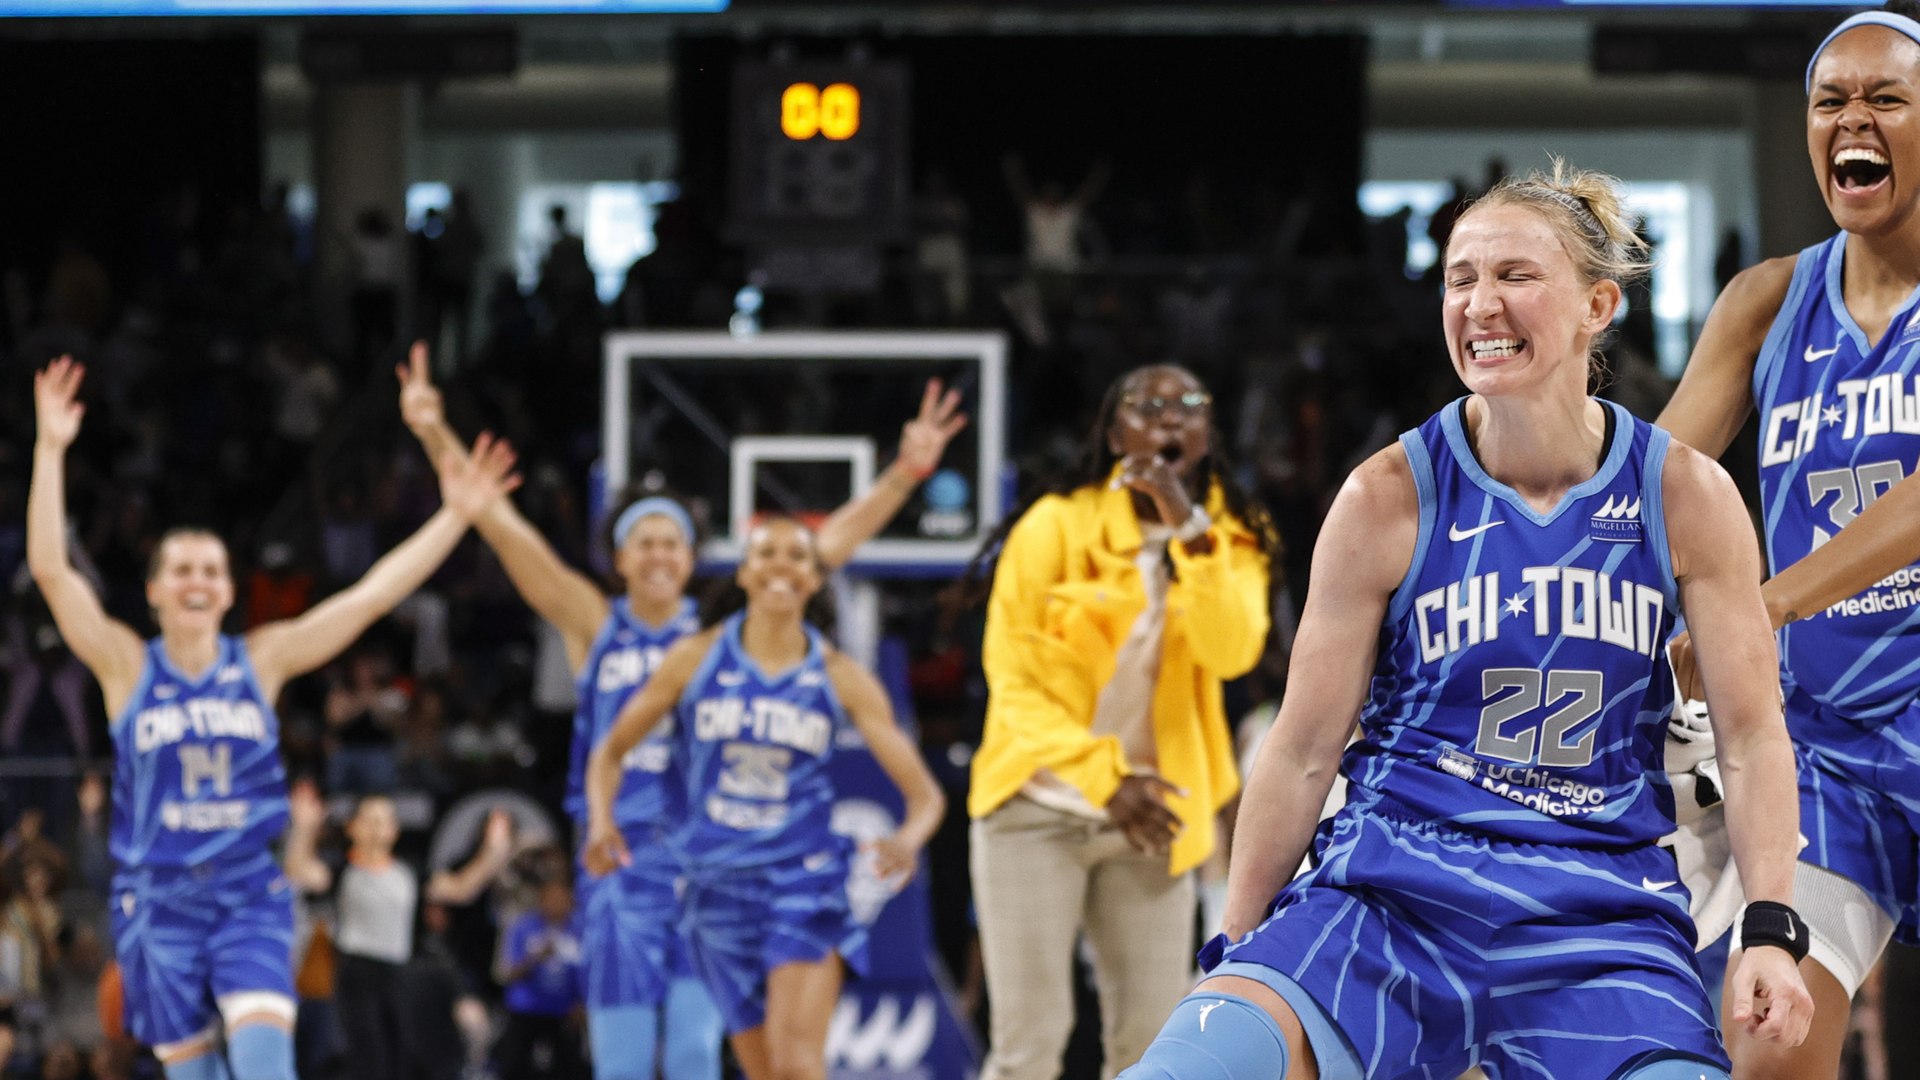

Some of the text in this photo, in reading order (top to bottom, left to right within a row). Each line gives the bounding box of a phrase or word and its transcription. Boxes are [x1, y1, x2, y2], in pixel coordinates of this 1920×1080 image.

[781, 82, 861, 141] 00
[1762, 372, 1920, 468] CH TOW
[1590, 520, 1643, 532] MAGELLAN
[1414, 565, 1664, 665] CHI TOWN
[1474, 667, 1604, 768] 22
[177, 742, 233, 799] 14
[719, 742, 792, 801] 35
[1487, 763, 1605, 805] UChicago
